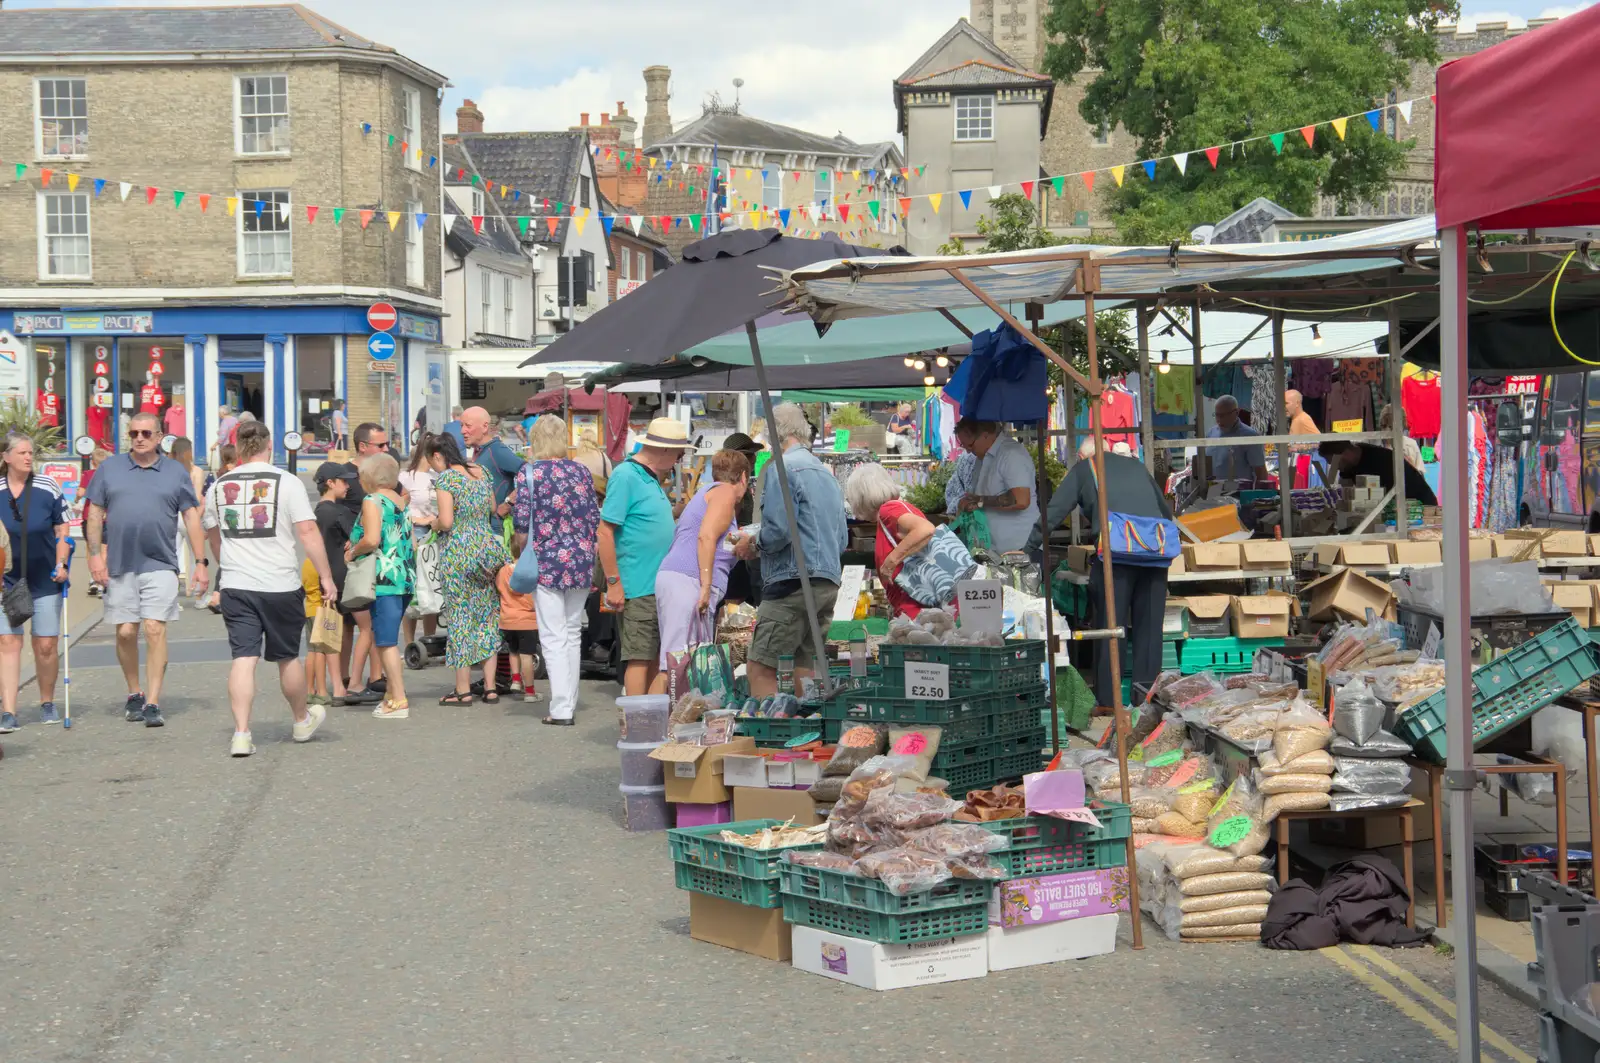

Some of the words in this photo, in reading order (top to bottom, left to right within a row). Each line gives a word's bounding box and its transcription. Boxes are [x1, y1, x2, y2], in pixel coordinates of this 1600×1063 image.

[34, 316, 62, 328] PACT
[104, 316, 132, 328] PACT
[95, 347, 107, 405] SALE
[1507, 382, 1536, 394] RAIL
[964, 589, 997, 601] £2.50
[911, 686, 944, 698] £2.50
[1063, 883, 1087, 899] SUET
[1087, 881, 1103, 896] 150
[1034, 886, 1062, 904] BALLS
[1071, 898, 1089, 908] SUPER
[928, 940, 940, 948] WAY
